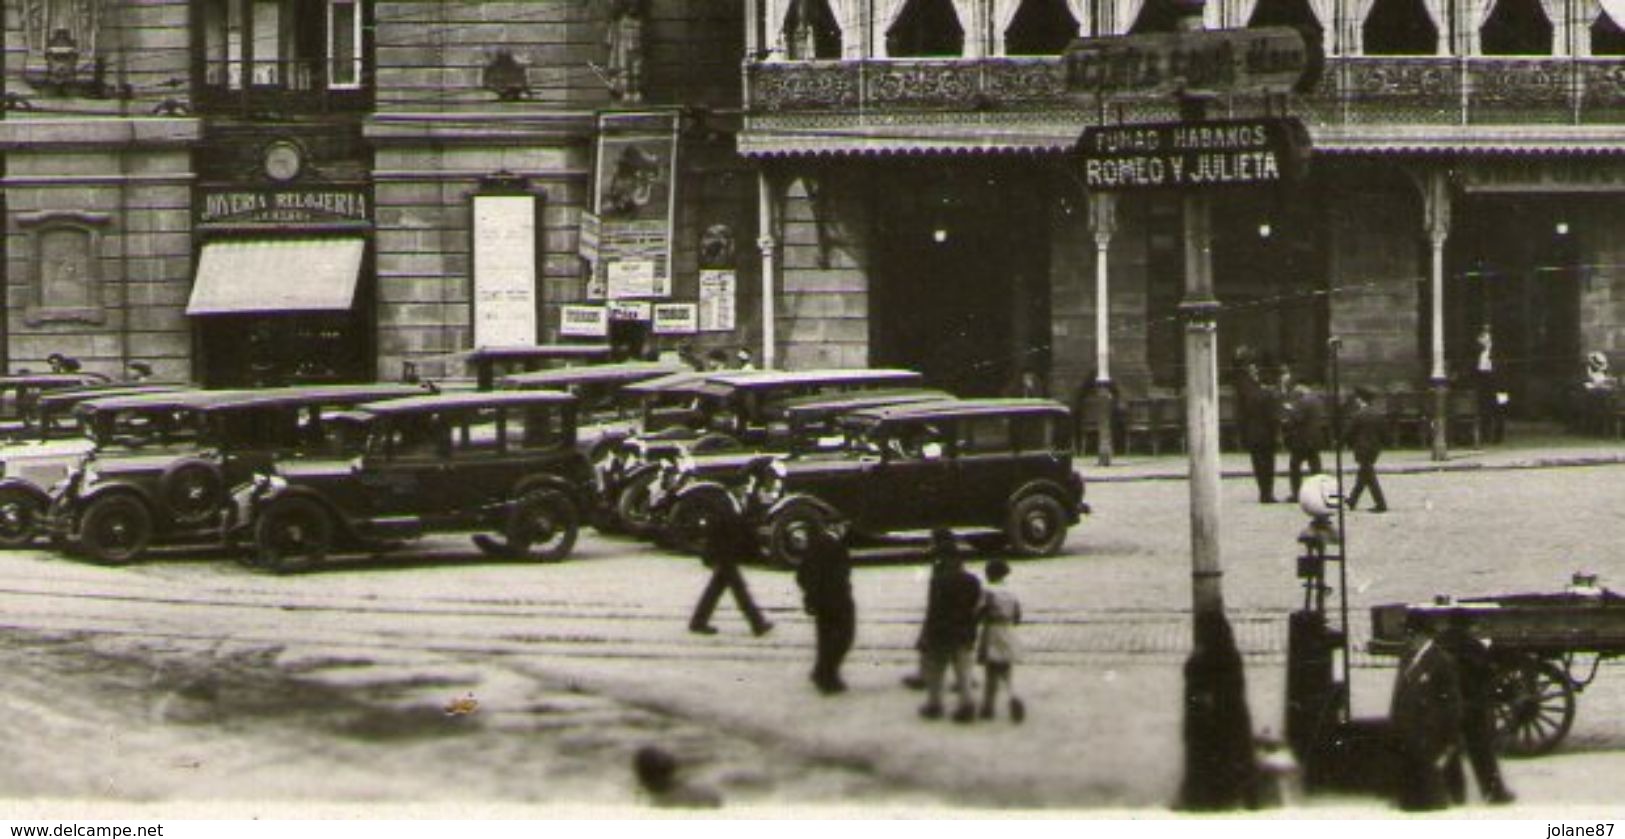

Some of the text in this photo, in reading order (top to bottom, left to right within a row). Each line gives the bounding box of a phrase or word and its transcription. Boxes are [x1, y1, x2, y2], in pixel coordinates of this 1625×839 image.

[1173, 125, 1266, 149] HABANOS
[1086, 151, 1280, 185] ROMEO Y JULIETA
[275, 191, 366, 220] RELOJERIA
